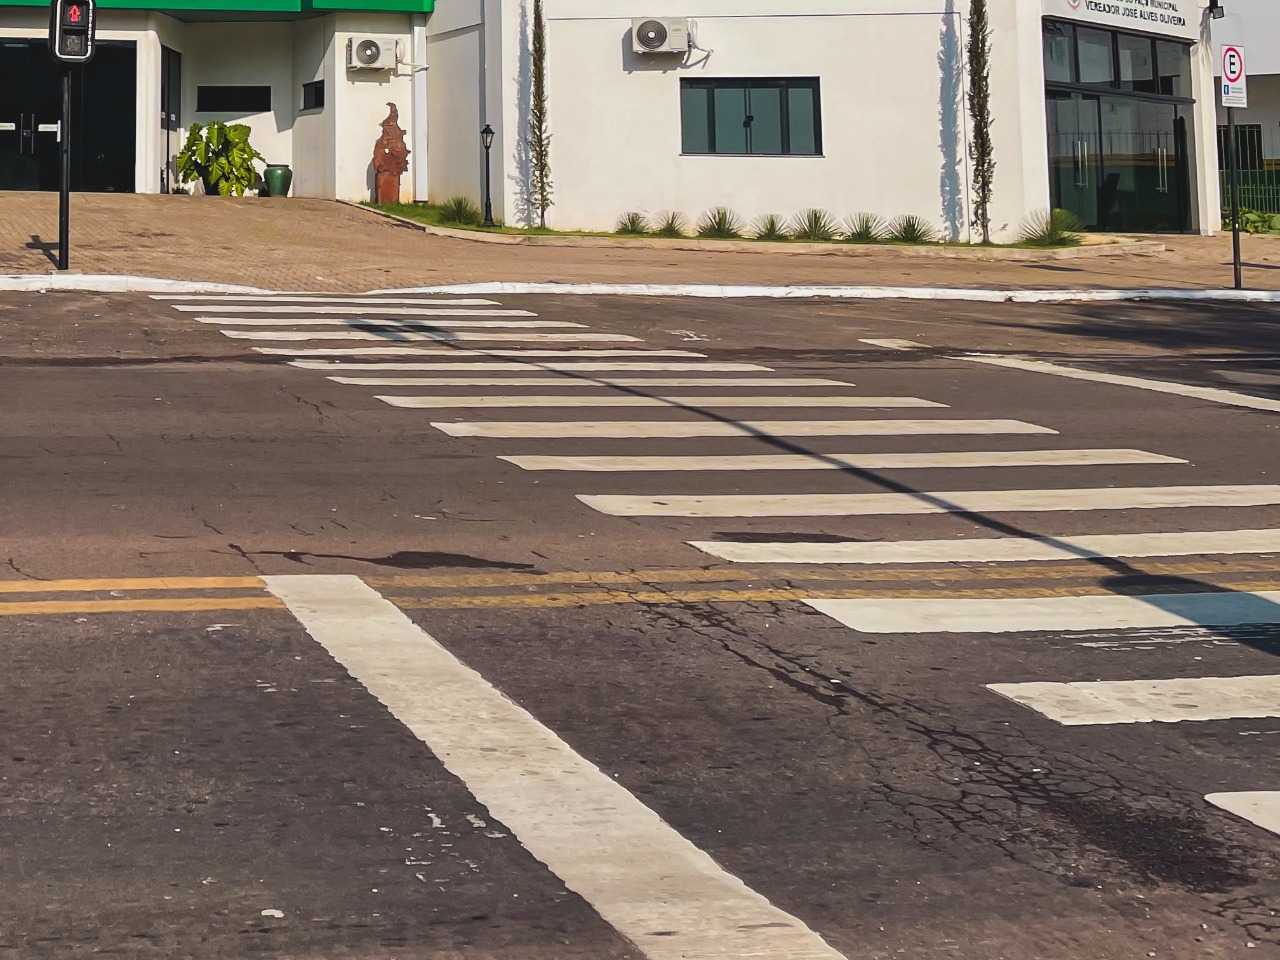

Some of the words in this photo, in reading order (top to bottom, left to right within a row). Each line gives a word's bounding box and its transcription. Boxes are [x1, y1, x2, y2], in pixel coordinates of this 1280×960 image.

[1084, 0, 1120, 15] VEREADOR
[1139, 10, 1159, 22] ALVES
[1159, 14, 1186, 27] OLIVEIRA
[1150, 0, 1179, 12] MUNICIPAL
[1229, 54, 1236, 74] E
